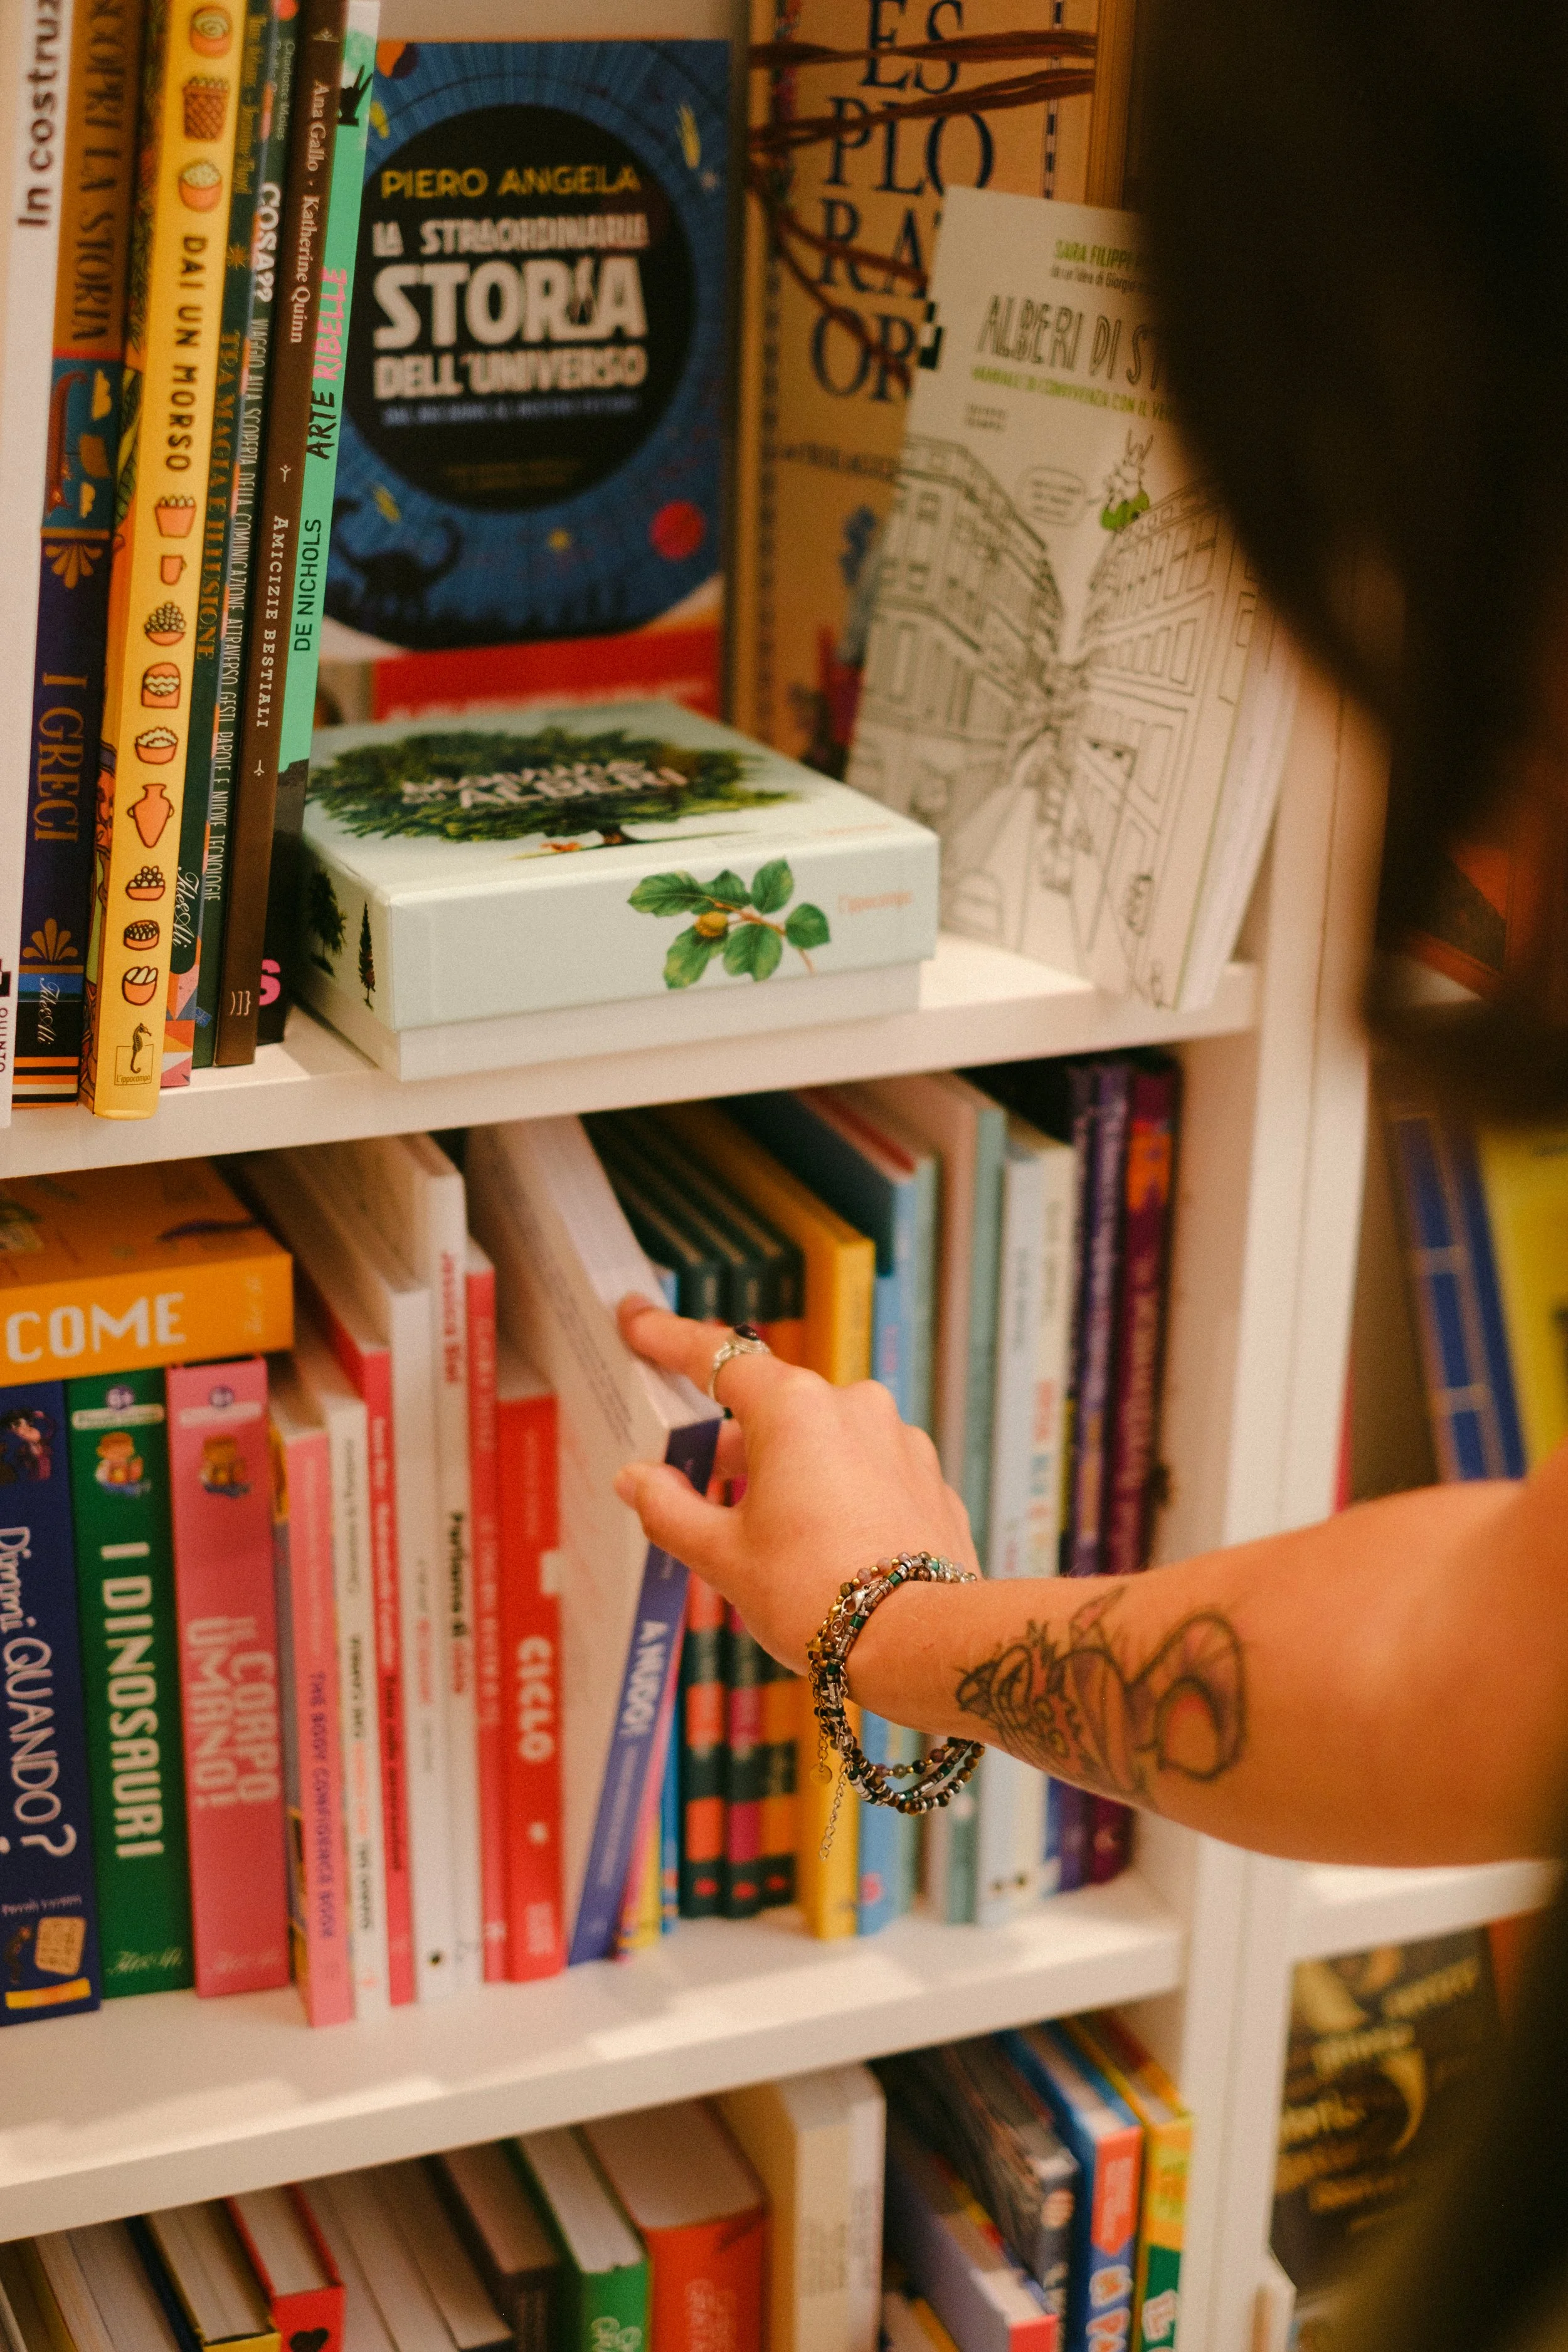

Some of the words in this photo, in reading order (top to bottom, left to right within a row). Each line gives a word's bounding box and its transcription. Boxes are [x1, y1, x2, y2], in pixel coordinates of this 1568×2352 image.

[278, 40, 296, 99] Charlotte
[861, 0, 963, 93] ES
[311, 80, 330, 118] Ana
[80, 147, 121, 193] LA
[305, 122, 326, 171] Gallo
[823, 97, 994, 198] PLO
[18, 186, 51, 229] In
[381, 168, 488, 198] PIERO
[498, 165, 641, 196] ANGELA
[178, 235, 208, 289] DAI
[295, 194, 320, 282] Katherine
[372, 221, 403, 257] LA
[818, 198, 943, 299] RA
[72, 211, 115, 342] STORIA
[373, 256, 649, 350] STORIA
[175, 306, 203, 347] UN
[247, 318, 268, 369] VIAGGIO
[290, 286, 311, 344] Quinn
[314, 268, 347, 381] RIBELLE
[977, 294, 1084, 373] ALBERI
[1089, 314, 1123, 381] DI
[217, 330, 241, 386] TRA
[373, 346, 648, 400] DELL'UNIVERSO
[164, 364, 197, 471] MORSO
[209, 394, 235, 489] MAGIA
[240, 408, 262, 464] SCOPERTA
[307, 391, 334, 460] ARTE
[208, 495, 227, 512] E
[196, 520, 225, 661] ILLUSIONE
[228, 513, 253, 611] COMUNICAZIONE
[265, 515, 289, 620] AMICIZIE
[297, 518, 322, 618] NICHOLS
[221, 618, 243, 684] ATTRAVERSO
[294, 624, 311, 652] DE
[42, 671, 87, 689] I
[256, 629, 277, 728] BESTIALI
[33, 706, 85, 843] GRECI
[208, 790, 230, 827] NUOVE
[36, 977, 61, 1044] IdeeAli
[5, 1292, 187, 1364] COME
[101, 1542, 150, 1560] I
[640, 1619, 670, 1643] A
[102, 1575, 165, 1859] DINOSAURI
[186, 1616, 238, 1809] UMANO!
[230, 1651, 280, 1803] CORPO
[516, 1636, 554, 1763] CICLO
[0, 1636, 77, 1858] QUANDO?
